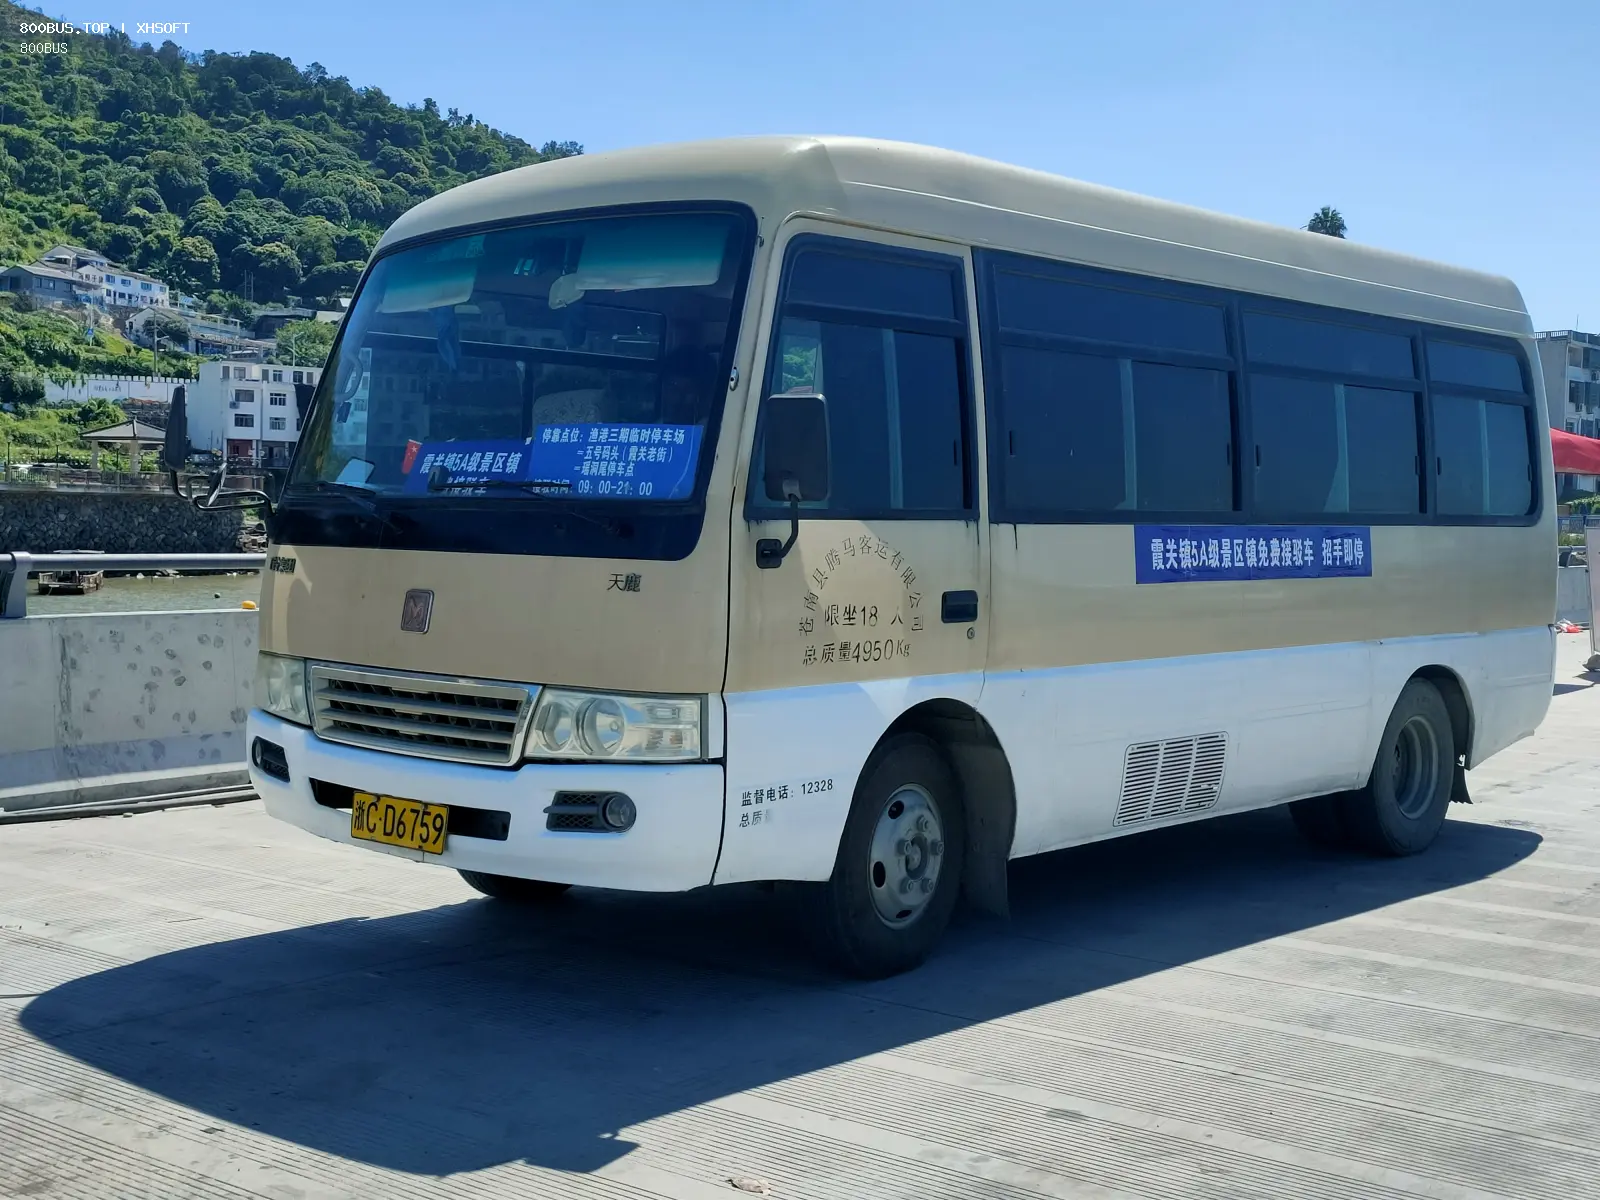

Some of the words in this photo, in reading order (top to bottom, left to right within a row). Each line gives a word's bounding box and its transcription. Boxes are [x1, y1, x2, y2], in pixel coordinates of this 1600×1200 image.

[1150, 537, 1315, 570] 霞关镇5A级景区镇免费接驳车
[1321, 537, 1364, 566] 招手即停
[607, 572, 642, 593] 天鹿
